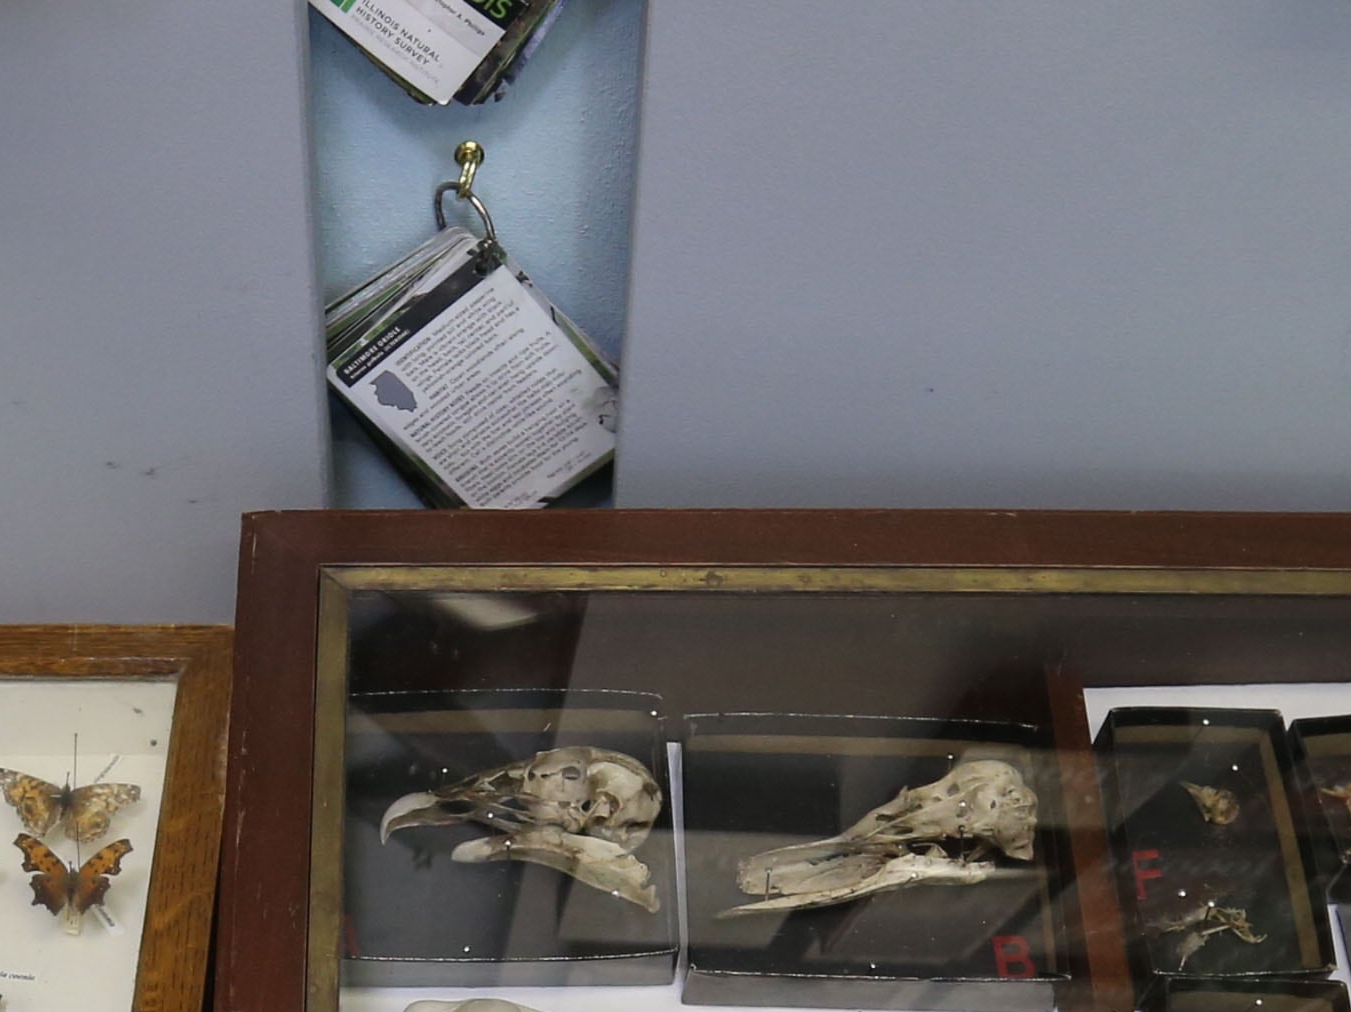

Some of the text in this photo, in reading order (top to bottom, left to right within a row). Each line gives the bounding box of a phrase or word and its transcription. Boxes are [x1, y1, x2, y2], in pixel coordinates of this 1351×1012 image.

[355, 6, 431, 66] HISTORY SURVEY
[401, 28, 441, 62] NATURAL
[341, 324, 402, 375] BALTIMORE ORIOLE
[1132, 848, 1162, 900] F
[992, 935, 1036, 978] B
